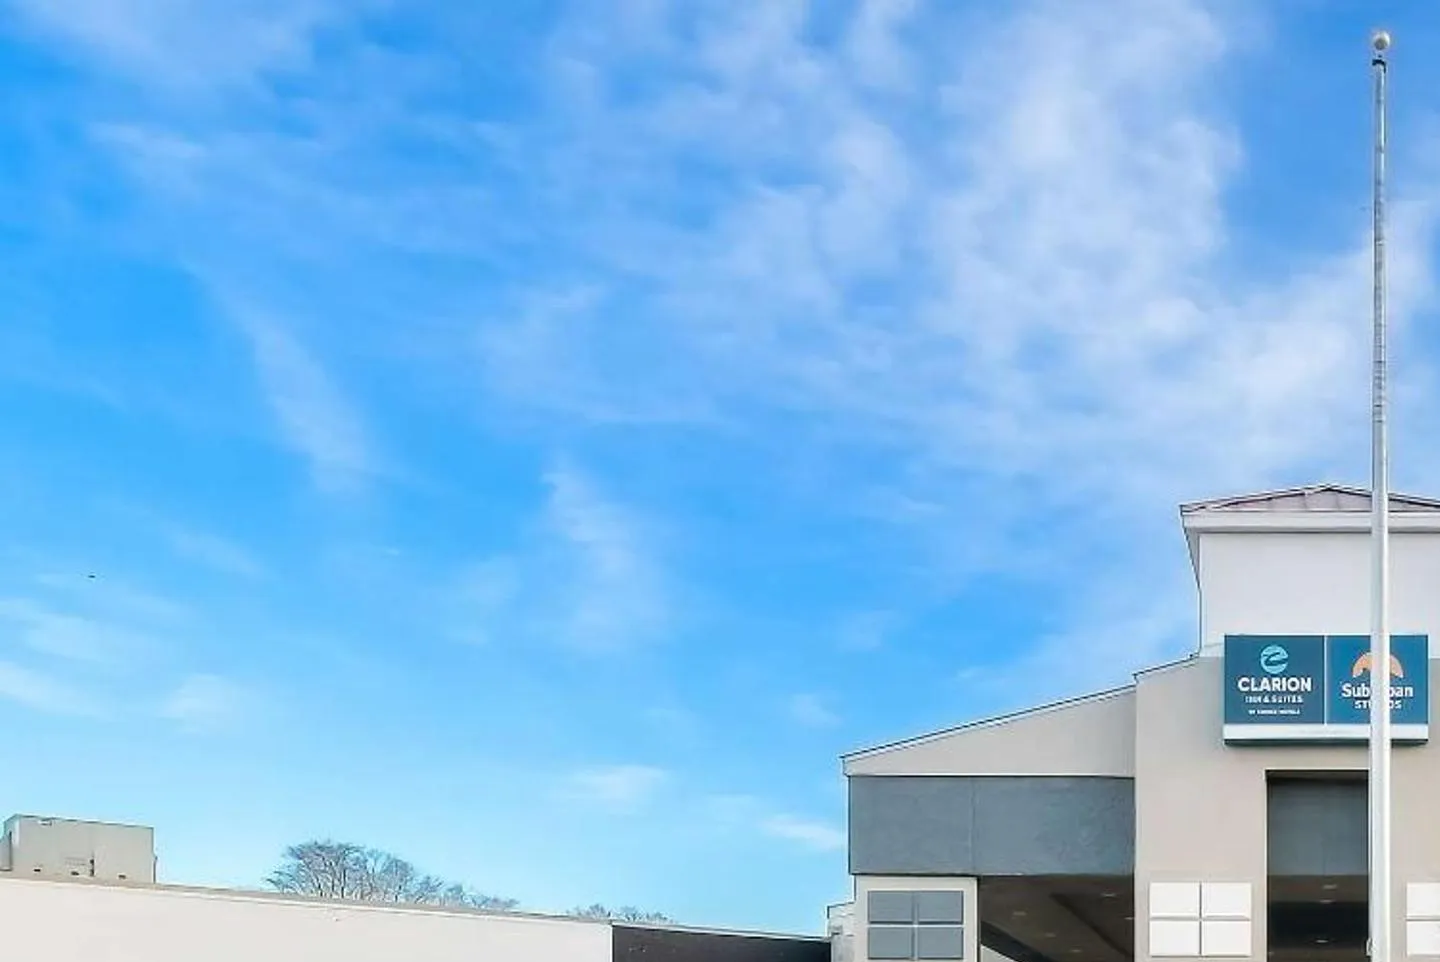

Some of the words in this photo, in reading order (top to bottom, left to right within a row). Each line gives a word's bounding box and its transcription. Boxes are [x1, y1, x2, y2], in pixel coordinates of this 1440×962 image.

[1238, 677, 1312, 691] CLARION
[1341, 683, 1414, 697] Subban
[1354, 700, 1402, 709] STOS
